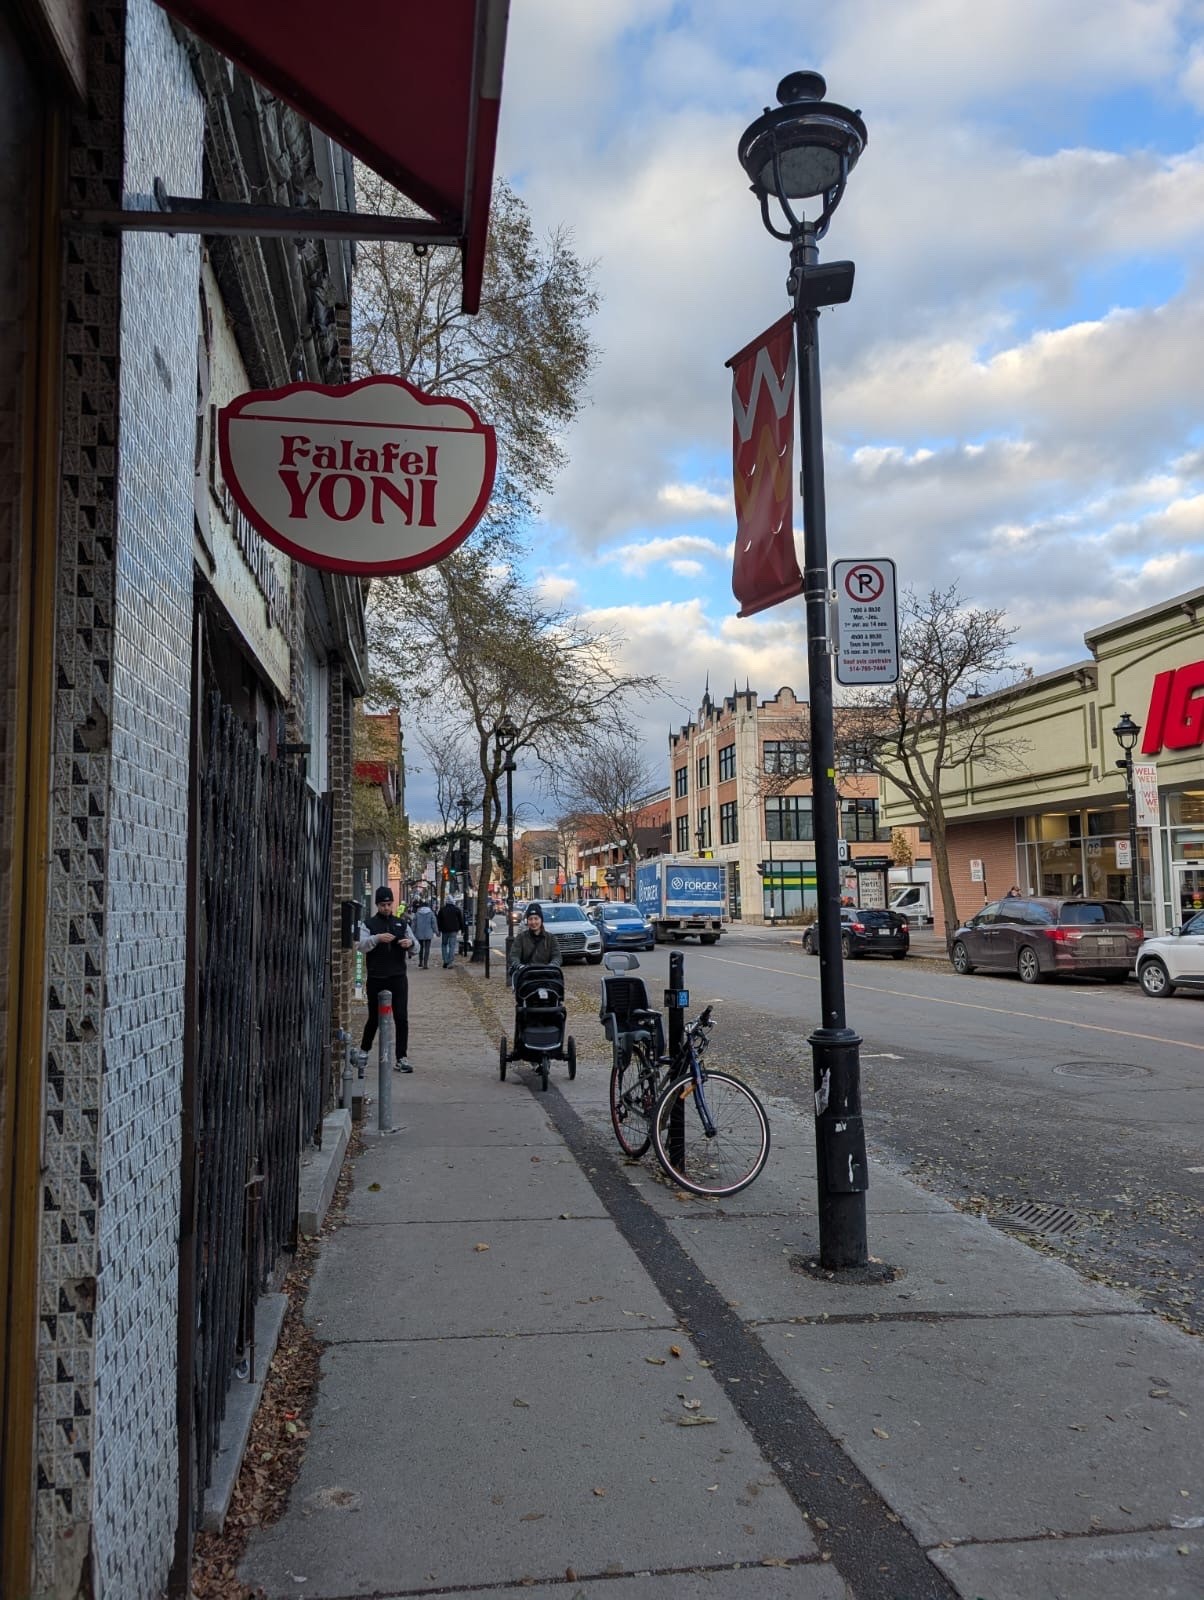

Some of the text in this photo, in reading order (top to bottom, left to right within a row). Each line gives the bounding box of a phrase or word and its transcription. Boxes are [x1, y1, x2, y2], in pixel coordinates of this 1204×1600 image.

[279, 435, 439, 477] Falafel
[278, 470, 438, 527] YONI
[858, 573, 873, 594] P
[1141, 660, 1204, 755] IG
[1135, 767, 1156, 775] WELL
[684, 881, 718, 890] FORGEX
